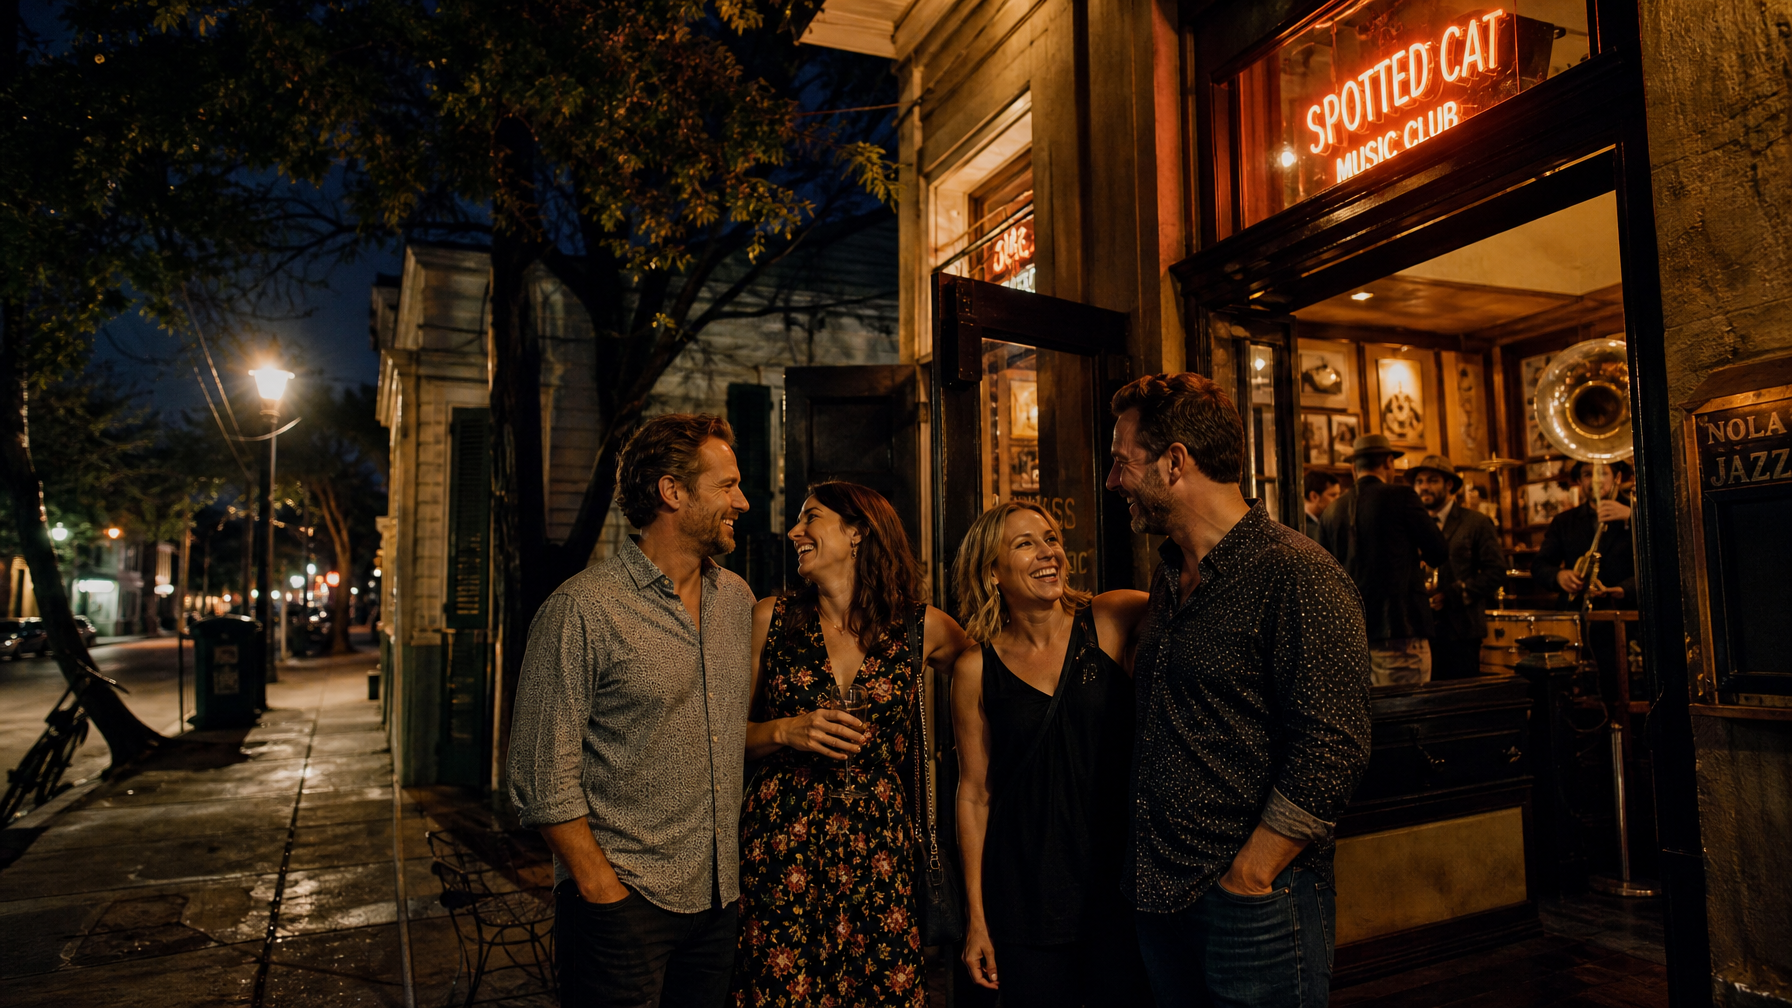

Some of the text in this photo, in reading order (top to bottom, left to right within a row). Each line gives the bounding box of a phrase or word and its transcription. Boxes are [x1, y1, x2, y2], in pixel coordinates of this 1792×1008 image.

[1306, 8, 1504, 154] SPOTTED CAT
[1336, 100, 1459, 184] MUSIC CLUB
[1707, 411, 1788, 445] NOLA
[1710, 447, 1792, 487] JAZZ
